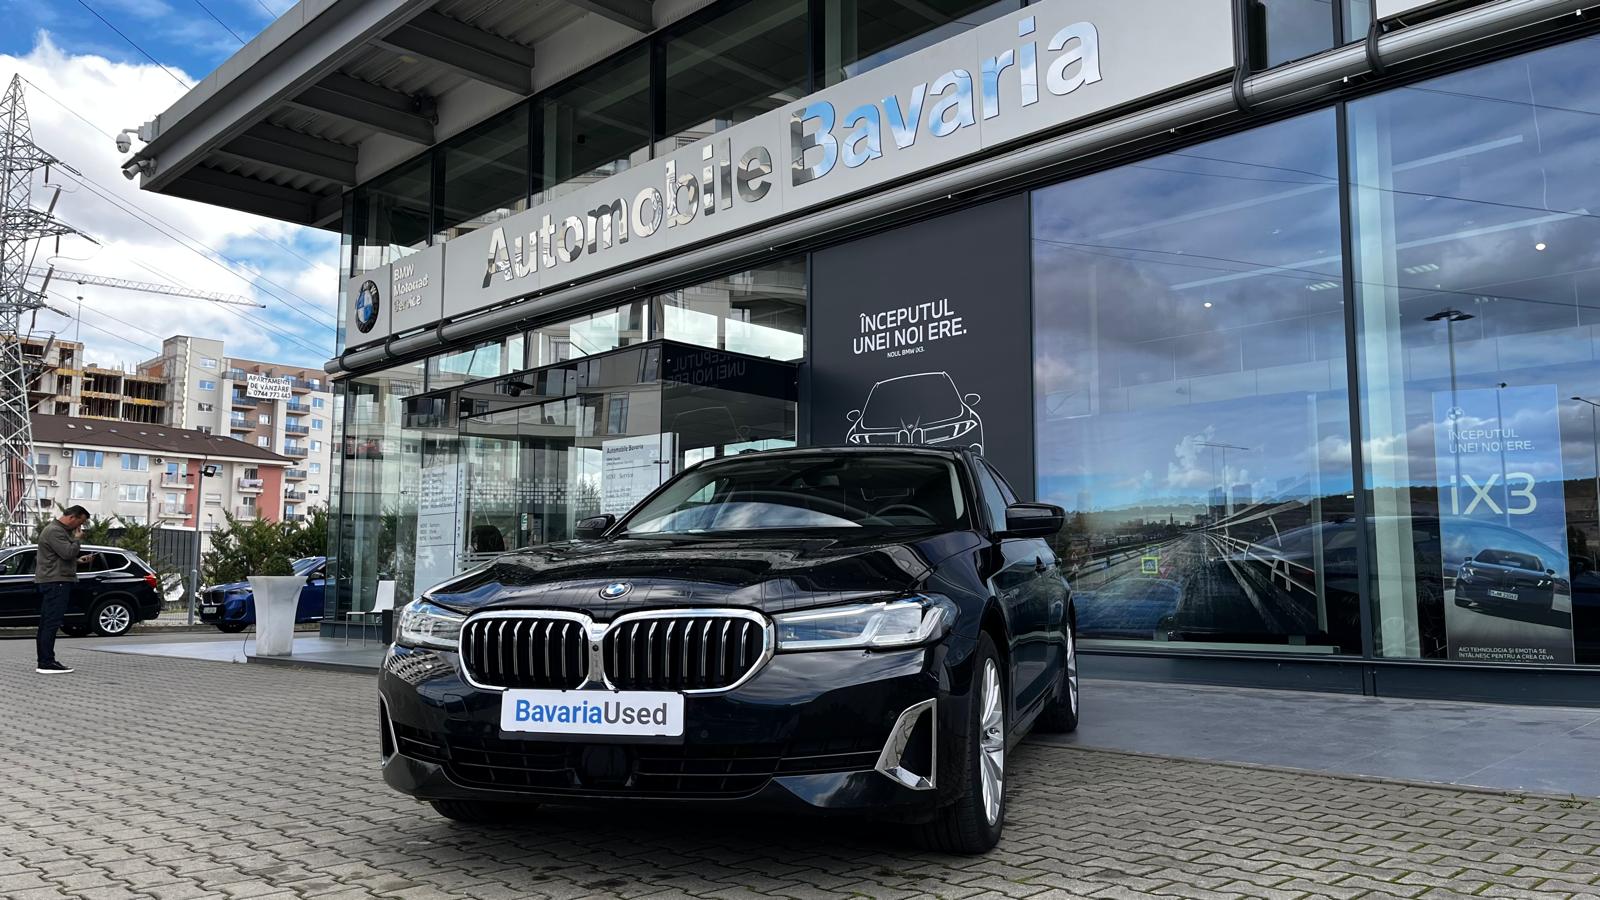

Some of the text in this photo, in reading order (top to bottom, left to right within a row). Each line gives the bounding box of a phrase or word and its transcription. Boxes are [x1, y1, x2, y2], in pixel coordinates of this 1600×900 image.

[481, 16, 1102, 288] Automobile Bavaria
[394, 263, 414, 280] BMW
[393, 274, 429, 297] Motorrad
[860, 298, 954, 333] ÎNCEPUTUL
[853, 317, 967, 355] UNEI NOI ERE.
[887, 350, 901, 358] NOUL
[250, 382, 259, 390] DE
[1449, 440, 1536, 454] UNEI NOI ERE.
[1450, 472, 1537, 515] iX3
[515, 699, 667, 725] BavariaUsed
